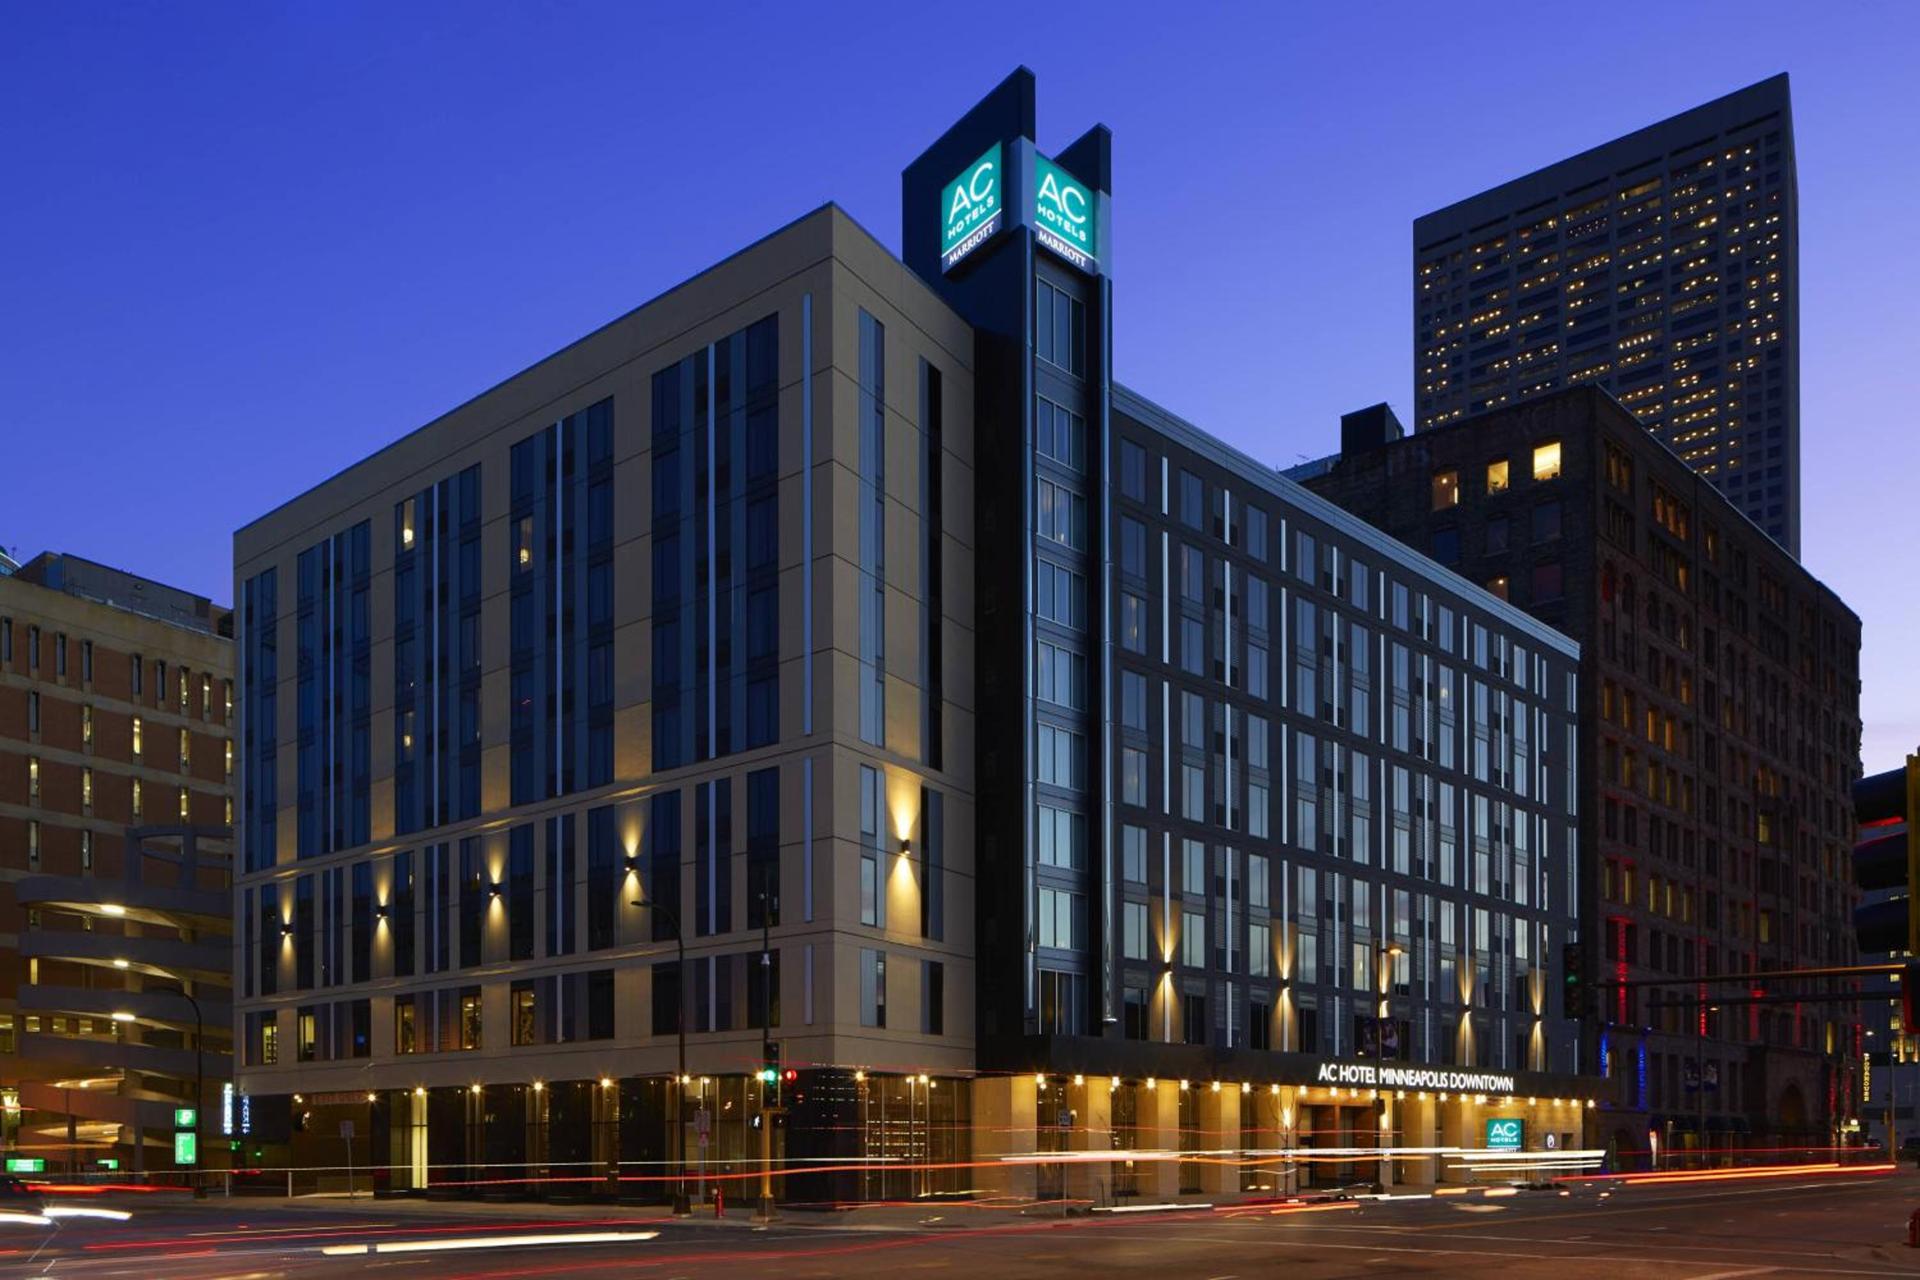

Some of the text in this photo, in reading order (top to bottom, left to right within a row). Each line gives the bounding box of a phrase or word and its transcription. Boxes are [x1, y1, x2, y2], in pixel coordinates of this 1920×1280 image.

[948, 162, 994, 225] AC
[1038, 172, 1086, 224] AC
[948, 195, 995, 240] HOTELS
[1037, 203, 1087, 242] HOTELS
[949, 220, 995, 265] MARRIOTT
[1038, 230, 1087, 267] MARRIOTT
[1318, 1063, 1514, 1092] AC HOTEL MINNEAPOLIS DOWNTOWN
[1490, 1122, 1518, 1137] AC
